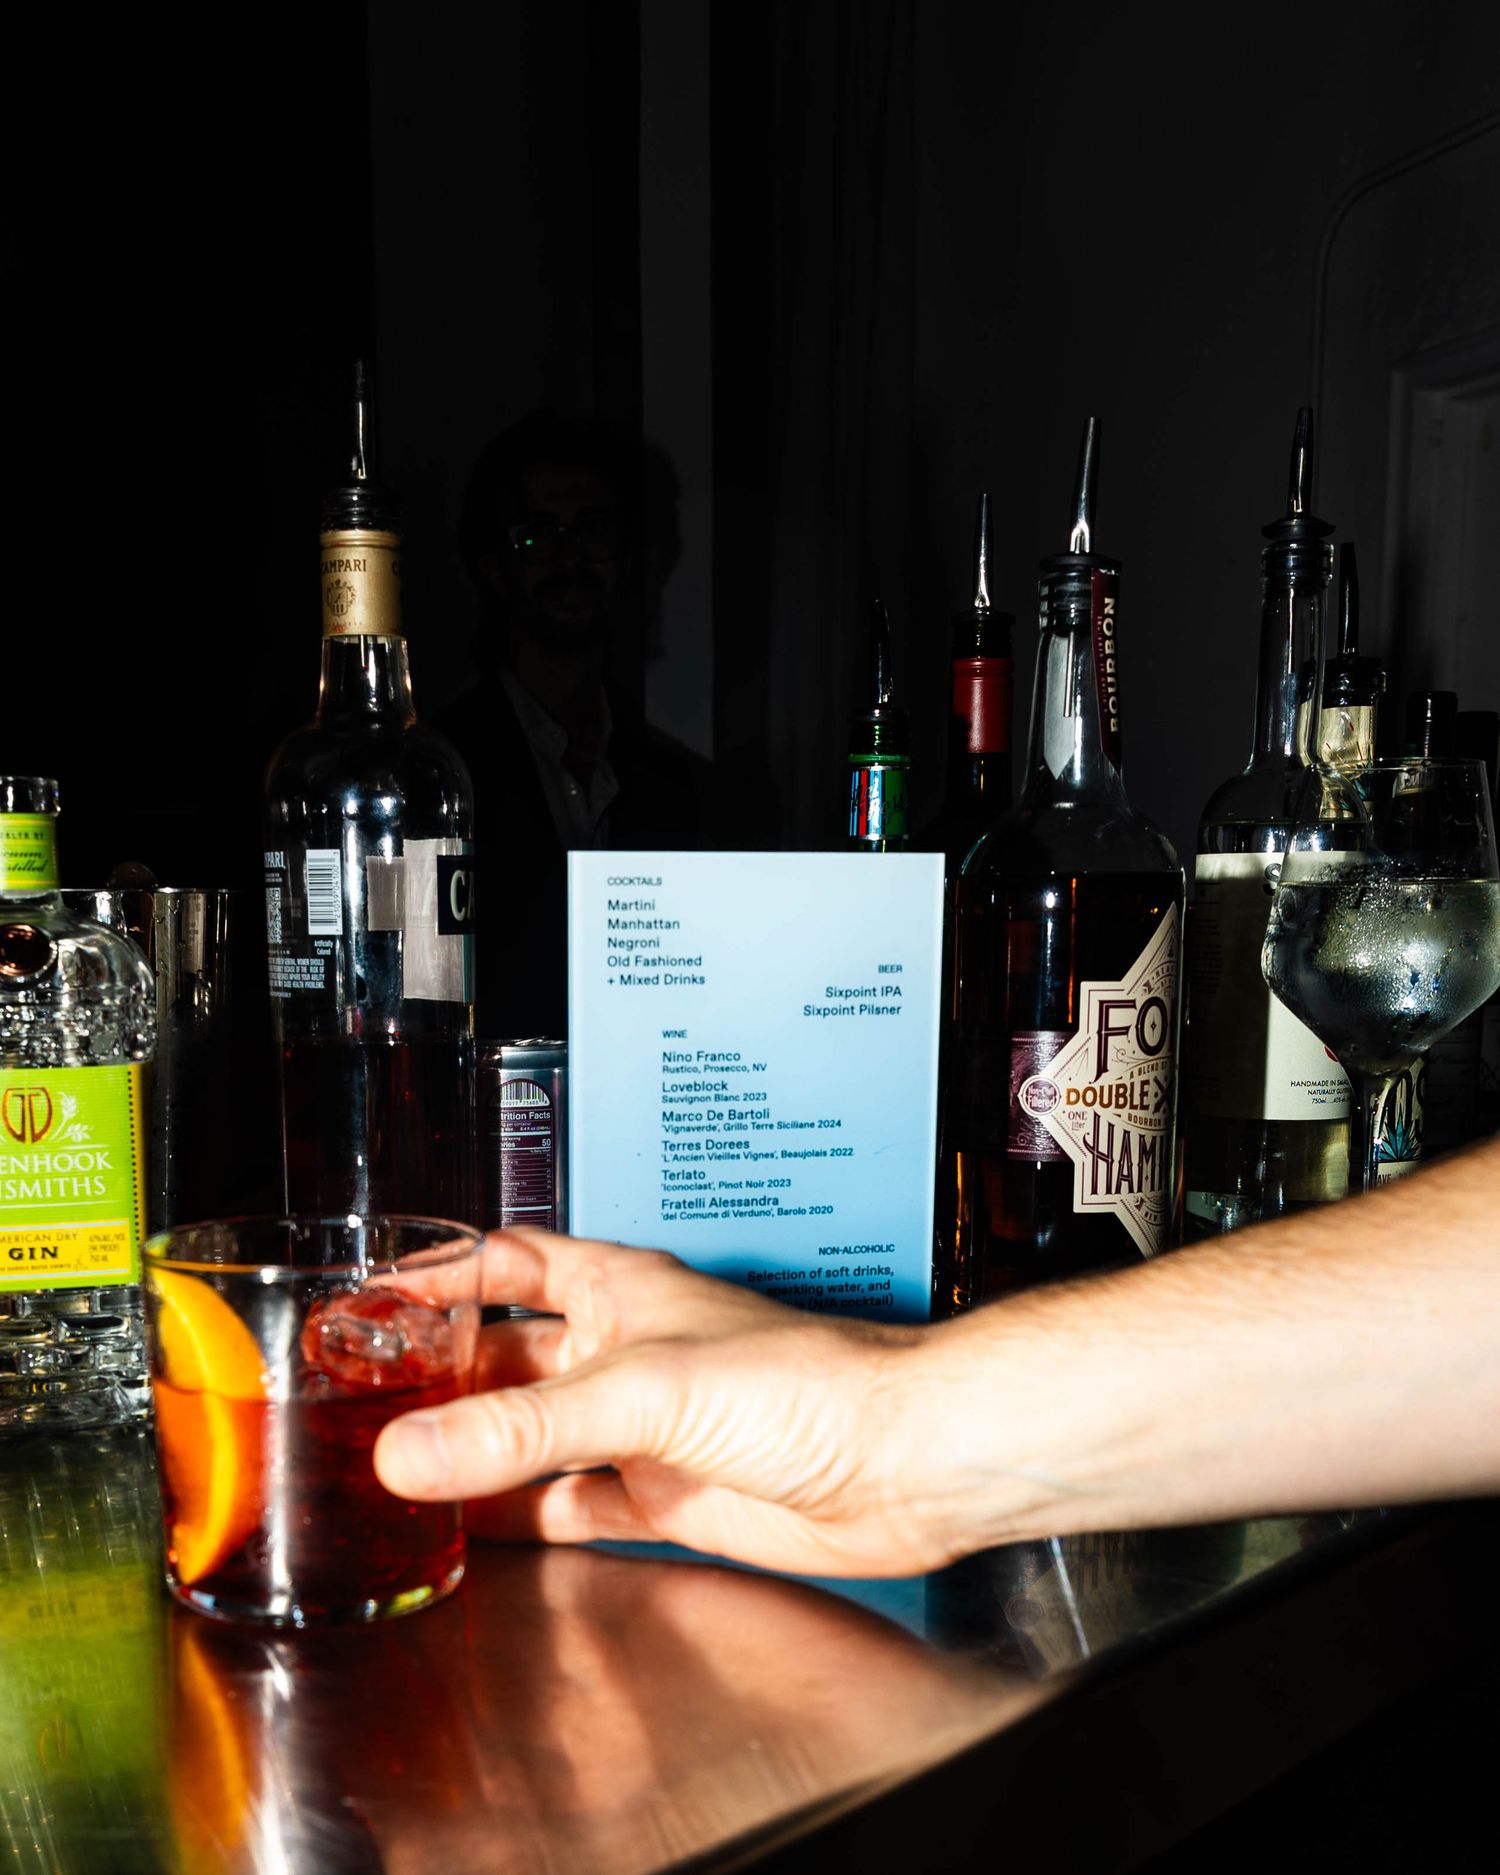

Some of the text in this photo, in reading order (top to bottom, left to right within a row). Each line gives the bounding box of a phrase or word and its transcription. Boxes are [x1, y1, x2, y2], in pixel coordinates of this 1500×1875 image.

[1102, 597, 1119, 733] BOURBON
[607, 877, 662, 886] COCKTAILS
[608, 900, 655, 910] Martini
[608, 918, 679, 929] Manhattan
[608, 937, 659, 951] Negroni
[608, 956, 701, 967] Old Fashioned
[878, 965, 902, 973] BEER
[620, 974, 659, 985] Mixed
[664, 974, 705, 985] Drinks
[826, 986, 902, 999] Sixpoint IPA
[804, 1004, 901, 1018] Sixpoint Pilsner
[663, 1030, 686, 1038] WINE
[663, 1051, 740, 1062] Nino Franco
[663, 1065, 701, 1074] Rustico,
[704, 1064, 749, 1072] Prosecco,
[1138, 1061, 1159, 1076] BLEND
[663, 1080, 728, 1092] Loveblock
[662, 1093, 767, 1105] Sauvignon Blanc 2023
[1066, 1079, 1150, 1111] DOUBLE
[1027, 1095, 1055, 1108] Filtered
[529, 1111, 551, 1119] Facts
[662, 1109, 769, 1122] Marco De Bartoli
[1068, 1111, 1087, 1121] ONE
[1128, 1112, 1162, 1127] BOURBON
[723, 1123, 748, 1131] Grillo
[751, 1122, 774, 1130] Terre
[777, 1121, 815, 1129] Siciliane
[818, 1120, 841, 1128] 2024
[542, 1139, 552, 1147] 50
[662, 1139, 749, 1151] Terres Dorees
[781, 1150, 827, 1159] Beaujolais
[830, 1148, 853, 1156] 2022
[662, 1170, 705, 1180] Terlato
[0, 1175, 106, 1200] SMITHS
[719, 1181, 742, 1189] Pinot
[746, 1180, 764, 1188] Noir
[768, 1179, 791, 1187] 2023
[662, 1197, 779, 1209] Fratelli Alessandra
[680, 1211, 718, 1220] Comune
[721, 1210, 730, 1218] di
[777, 1207, 806, 1216] Barolo
[809, 1206, 833, 1214] 2020
[56, 1231, 78, 1242] DRY
[8, 1246, 59, 1261] GIN
[819, 1244, 895, 1255] NON-ALCOHOLIC
[747, 1266, 894, 1282] Selection of soft drinks,
[827, 1282, 864, 1294] water,
[867, 1281, 890, 1291] and
